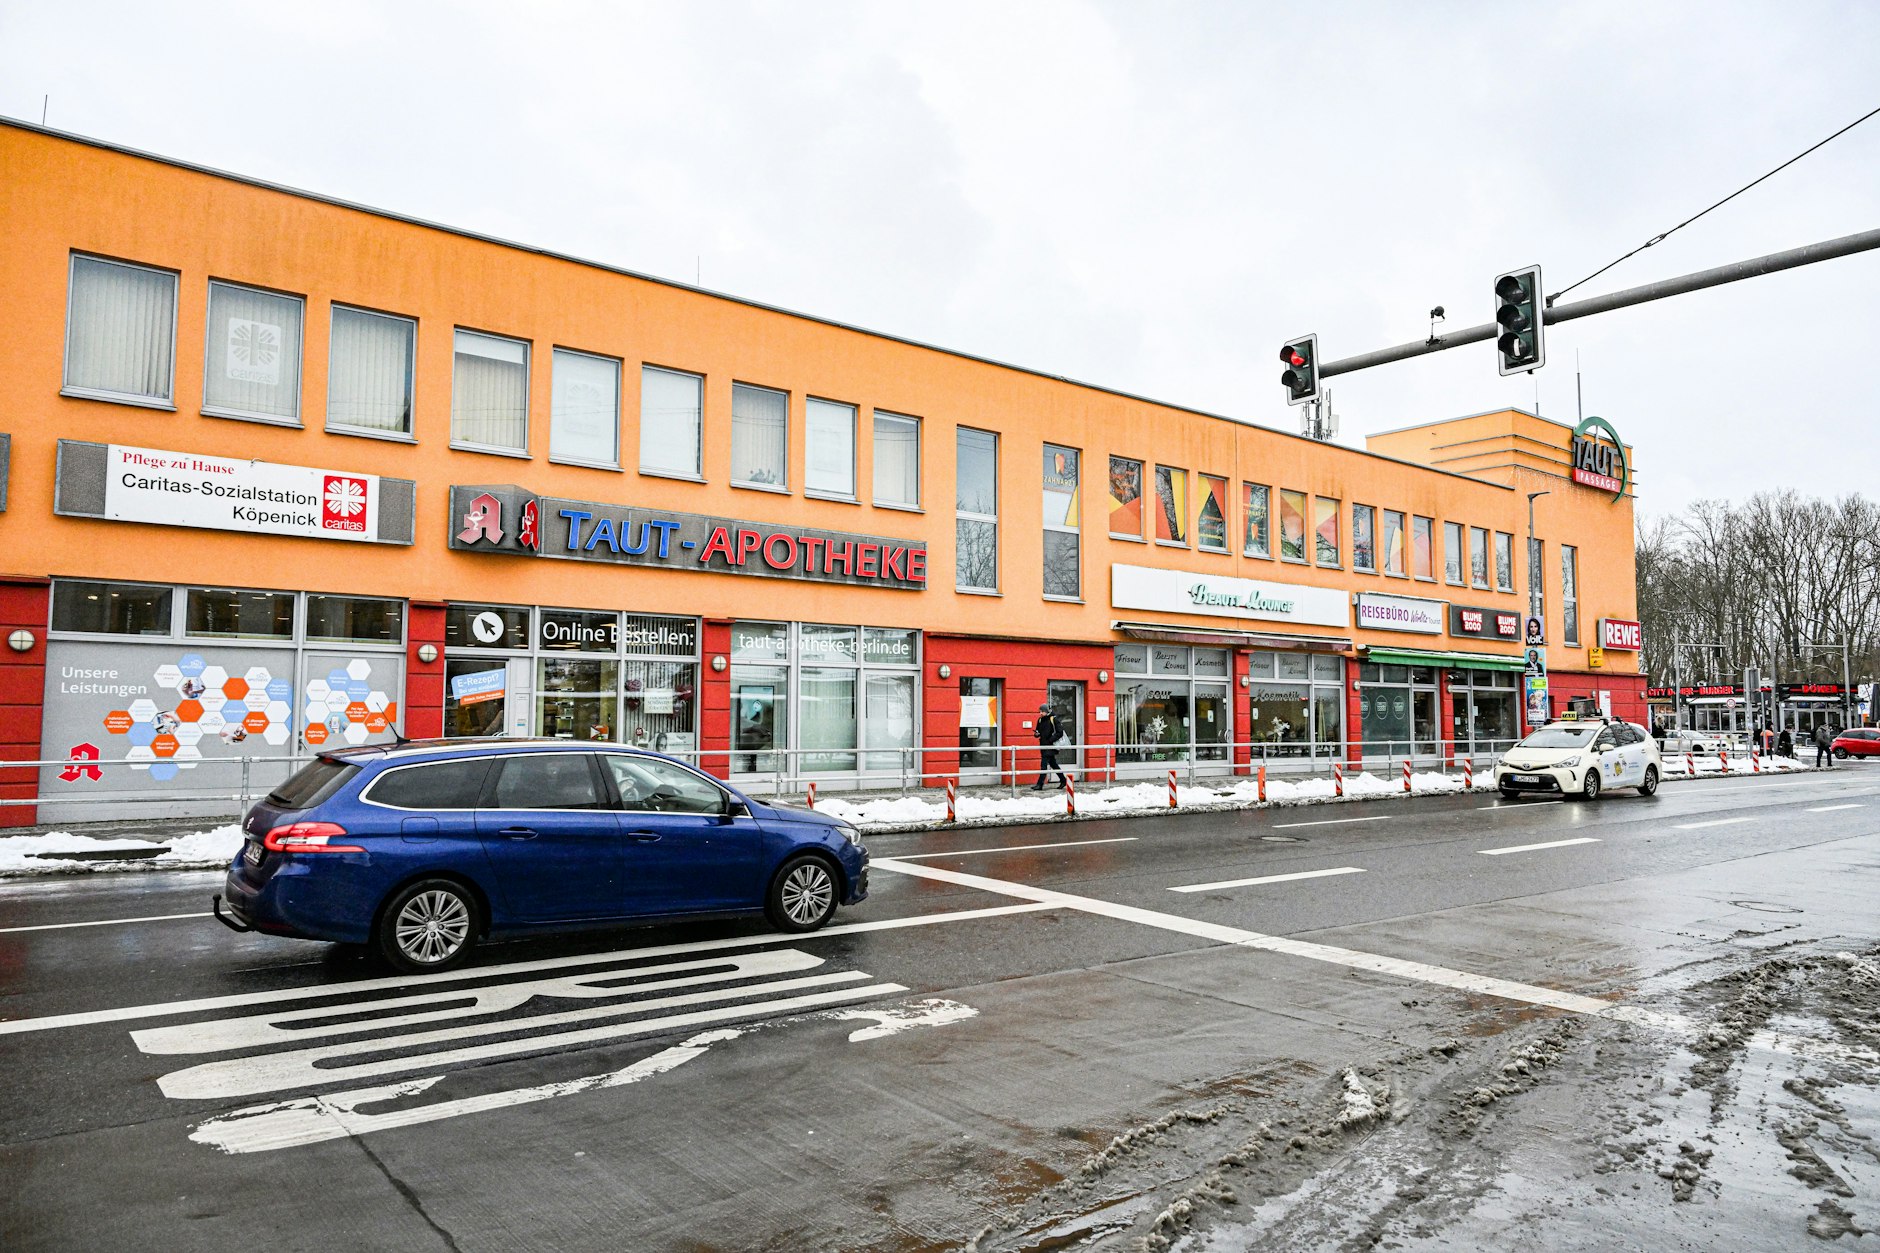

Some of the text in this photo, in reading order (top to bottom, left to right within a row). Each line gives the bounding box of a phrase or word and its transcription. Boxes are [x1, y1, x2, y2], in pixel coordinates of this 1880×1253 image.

[123, 452, 236, 475] Pflege zu Hause
[1574, 436, 1619, 477] TAUT
[1043, 476, 1076, 487] ZAHNARZT
[1580, 472, 1616, 490] PASSAGE
[122, 473, 318, 506] Caritas-Sozialstation
[232, 505, 317, 527] Köpenick
[325, 518, 364, 532] caritas
[1361, 604, 1409, 622] REISEBÜRO
[1462, 611, 1483, 623] BLUME
[1464, 621, 1482, 632] 2000
[1497, 615, 1517, 627] BLUME
[542, 621, 606, 643] Online
[1499, 625, 1516, 635] 2000
[1606, 622, 1640, 647] REWE
[1115, 654, 1141, 663] Friseur
[1195, 658, 1226, 667] Kosmetik
[62, 666, 119, 679] Unsere
[457, 673, 499, 688] E-Rezept?
[61, 682, 147, 697] Leistungen
[1253, 688, 1300, 703] Kosmetik
[1648, 688, 1666, 696] CITY
[1700, 686, 1734, 695] BURGER
[1802, 684, 1838, 694] DÖNER
